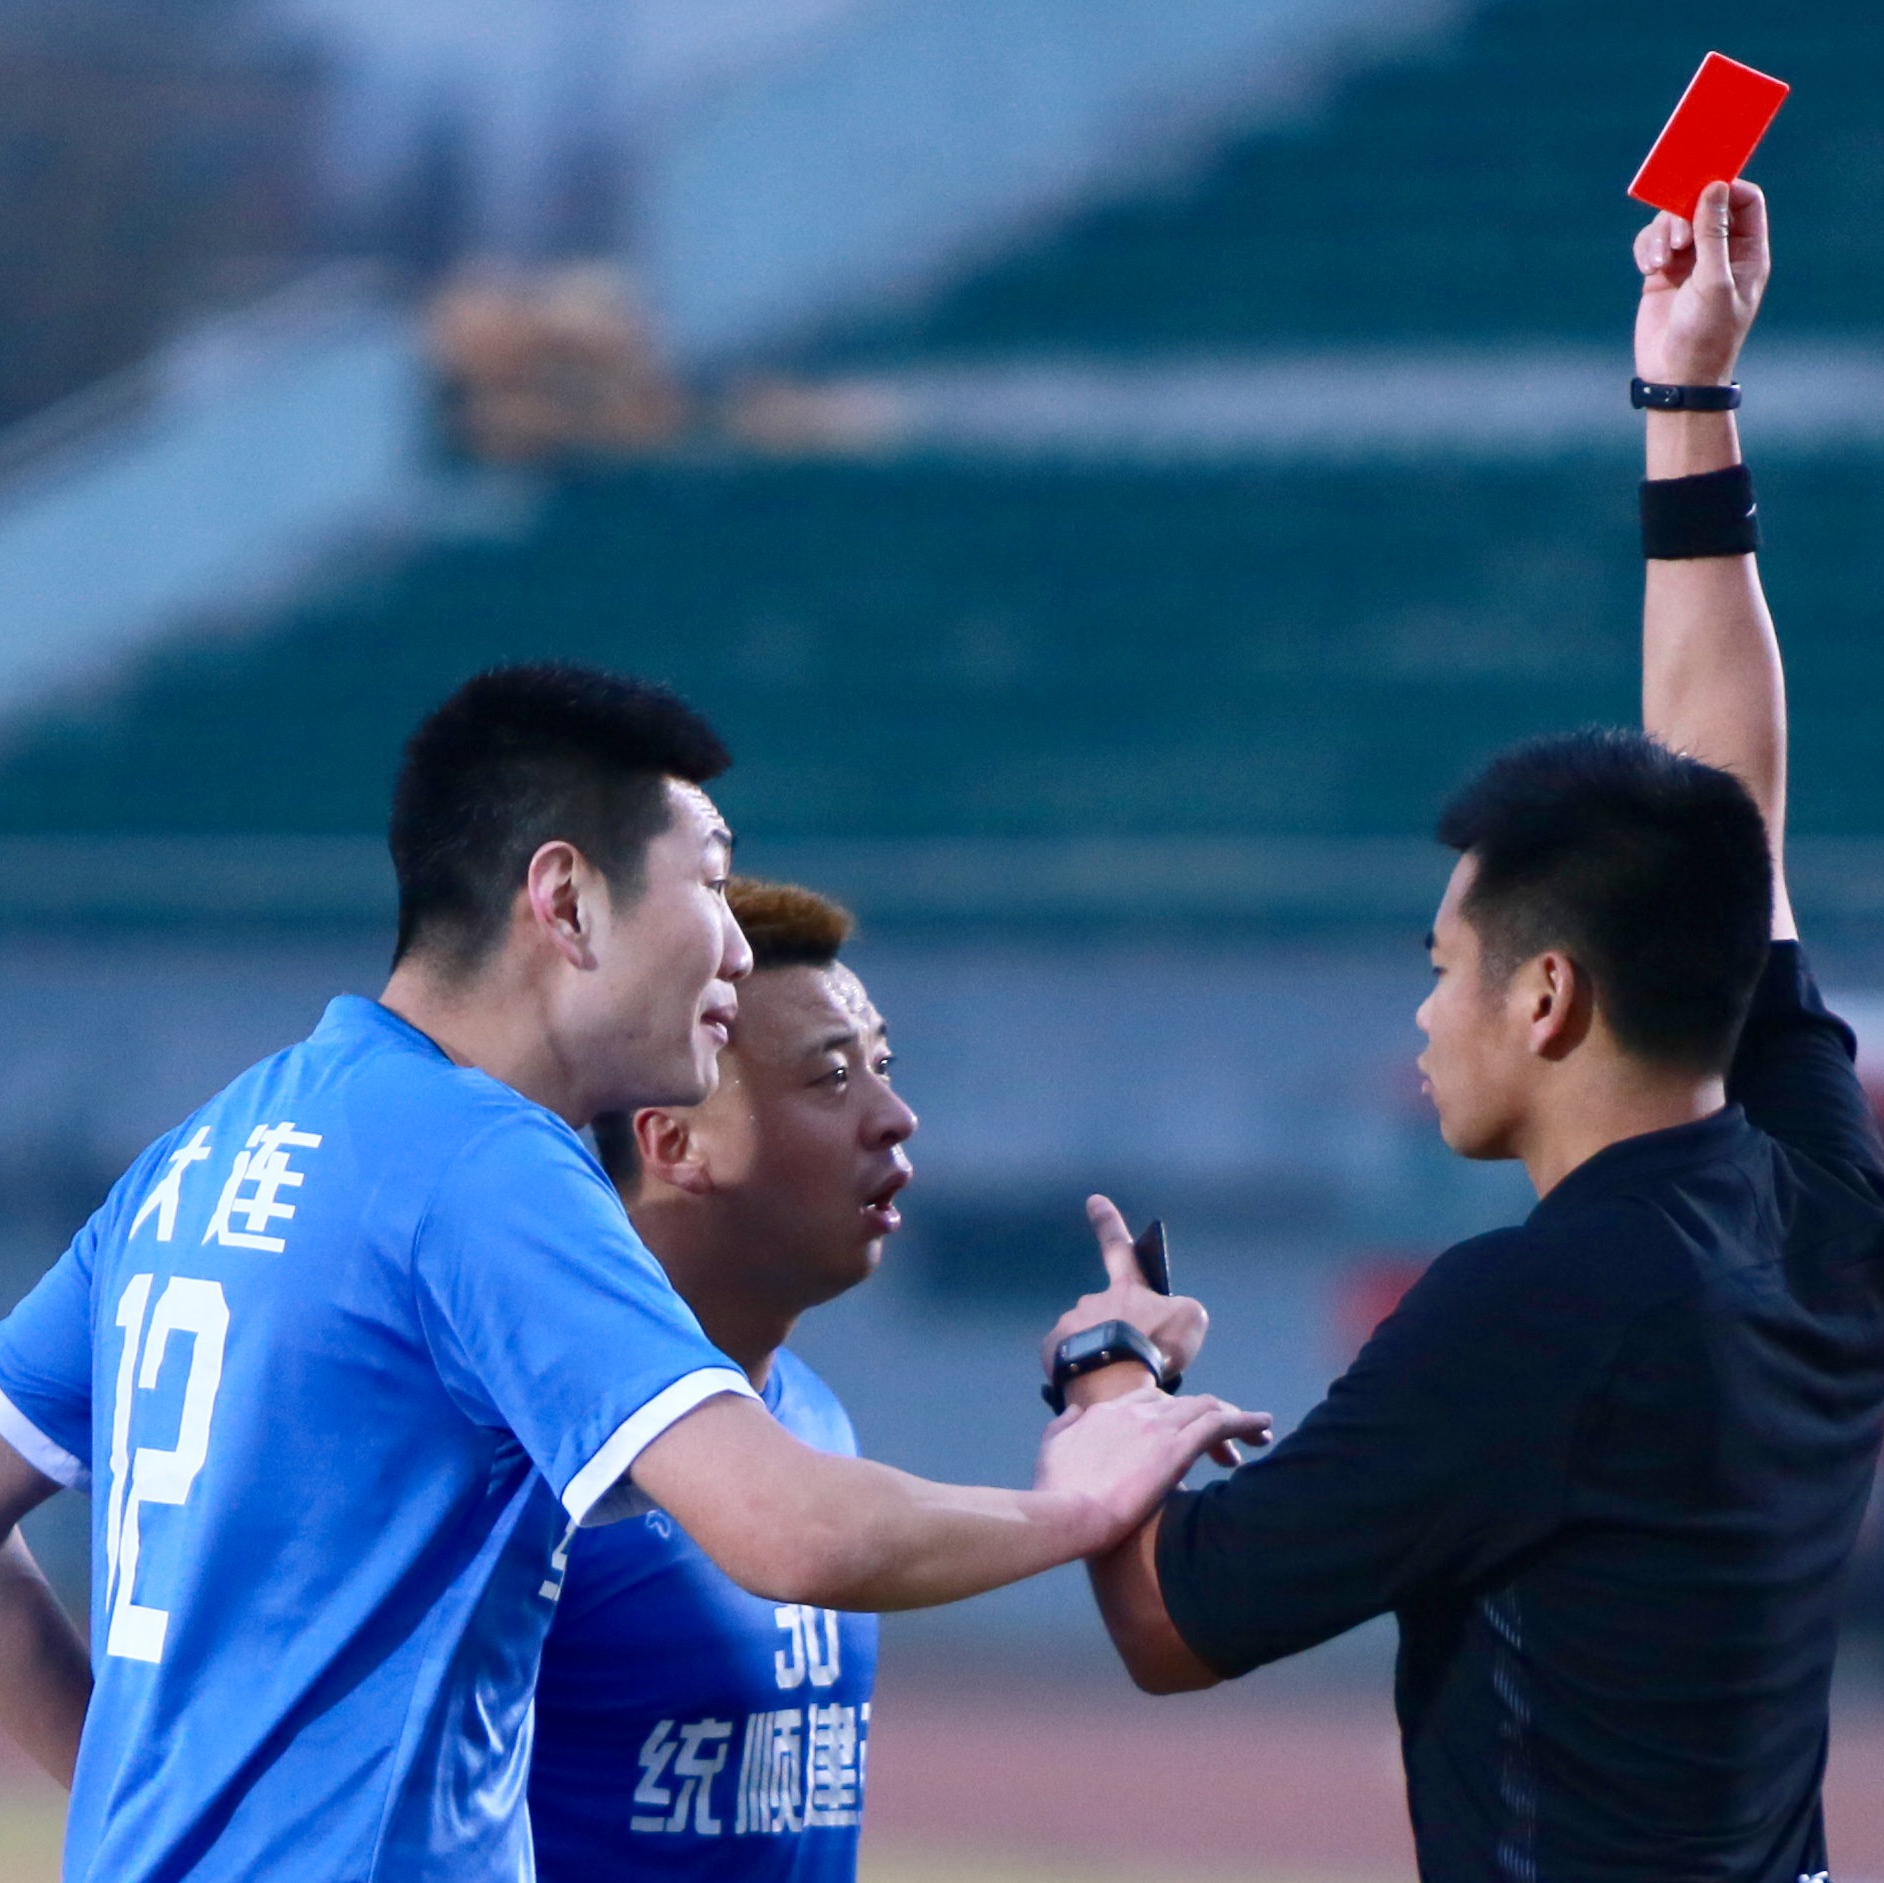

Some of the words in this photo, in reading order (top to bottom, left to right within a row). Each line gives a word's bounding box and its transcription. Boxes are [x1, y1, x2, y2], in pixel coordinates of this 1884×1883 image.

[127, 1121, 323, 1253] 大连
[106, 1273, 230, 1662] 12
[630, 1703, 871, 1835] 统顺建
